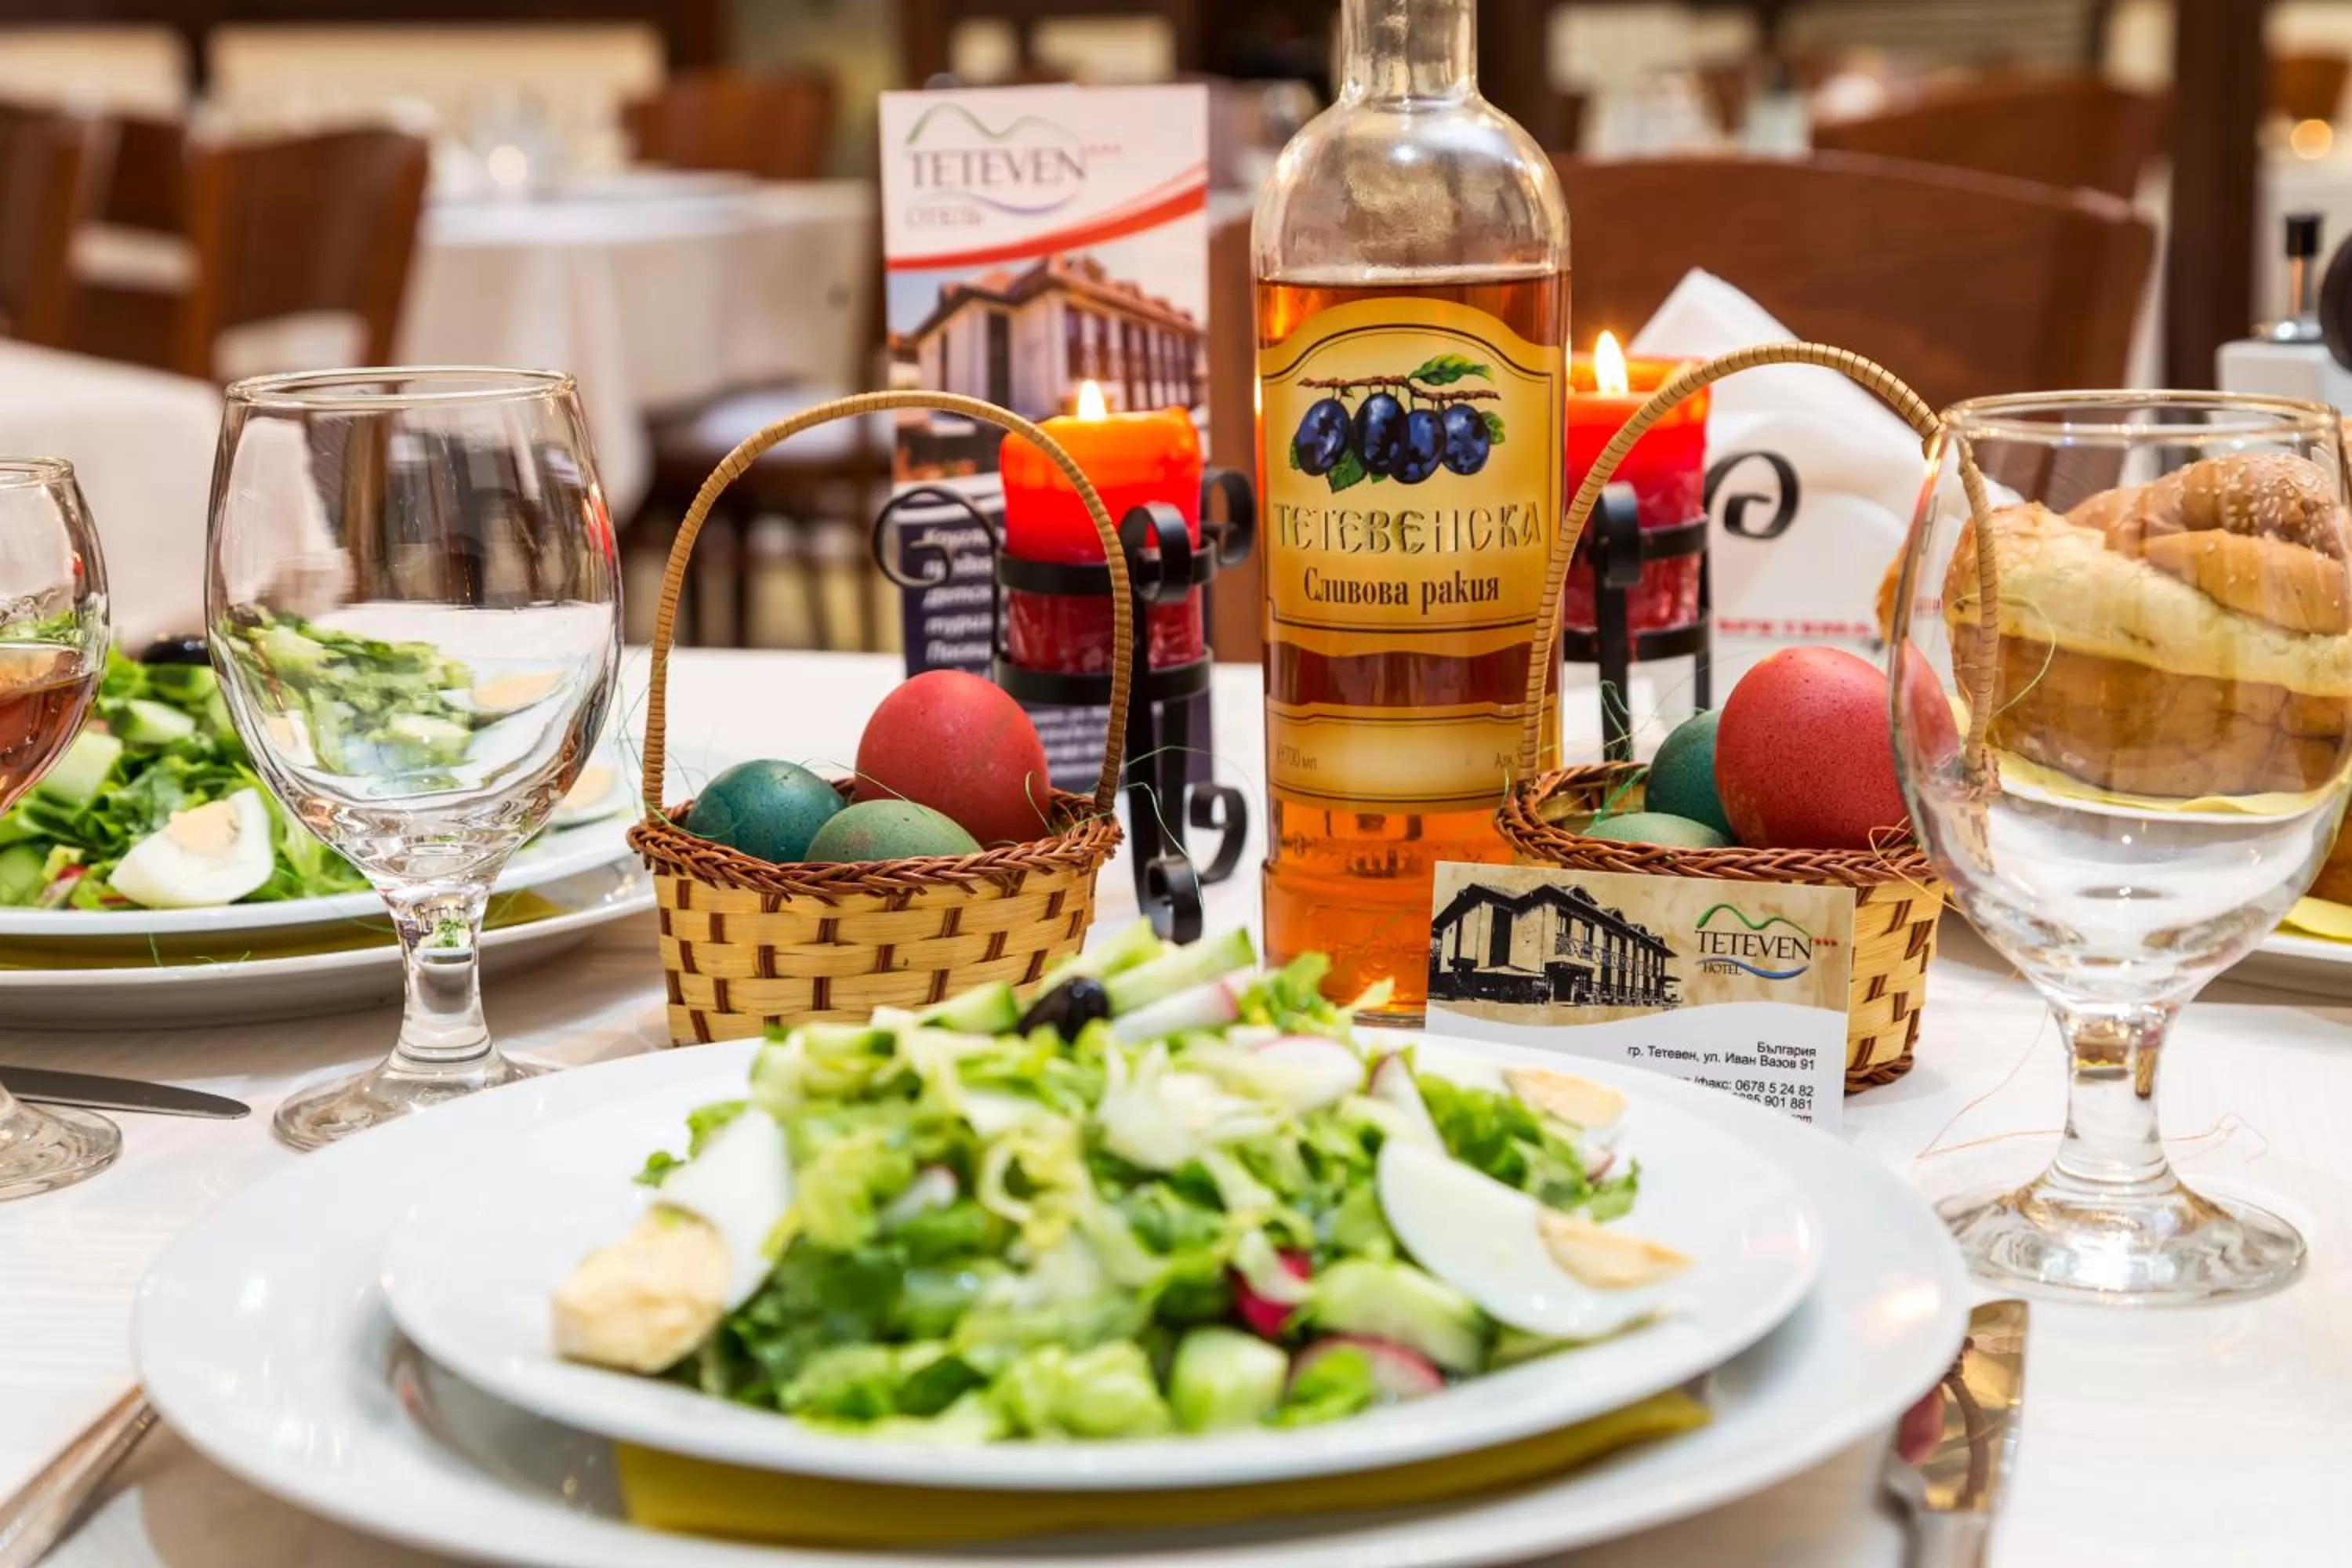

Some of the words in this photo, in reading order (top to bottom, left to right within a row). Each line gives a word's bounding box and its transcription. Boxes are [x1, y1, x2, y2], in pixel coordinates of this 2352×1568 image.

[906, 147, 1087, 189] TETEVEN
[1304, 567, 1410, 606] Сливова
[1421, 570, 1500, 615] ракия
[1694, 931, 1813, 961] TETEVEN
[1703, 960, 1742, 976] HOTEL
[1628, 1045, 1643, 1058] гр.
[1647, 1045, 1700, 1062] Тетевен,
[1704, 1053, 1721, 1065] ул.
[1725, 1052, 1757, 1065] Иван
[1760, 1055, 1797, 1069] Вазов
[1800, 1058, 1815, 1071] 91
[1757, 1040, 1817, 1058] България
[1735, 1080, 1765, 1093] 0678
[1769, 1083, 1777, 1094] 5
[1780, 1083, 1795, 1095] 24
[1798, 1084, 1814, 1098] 82
[1765, 1095, 1786, 1108] 901
[1790, 1098, 1812, 1111] 881
